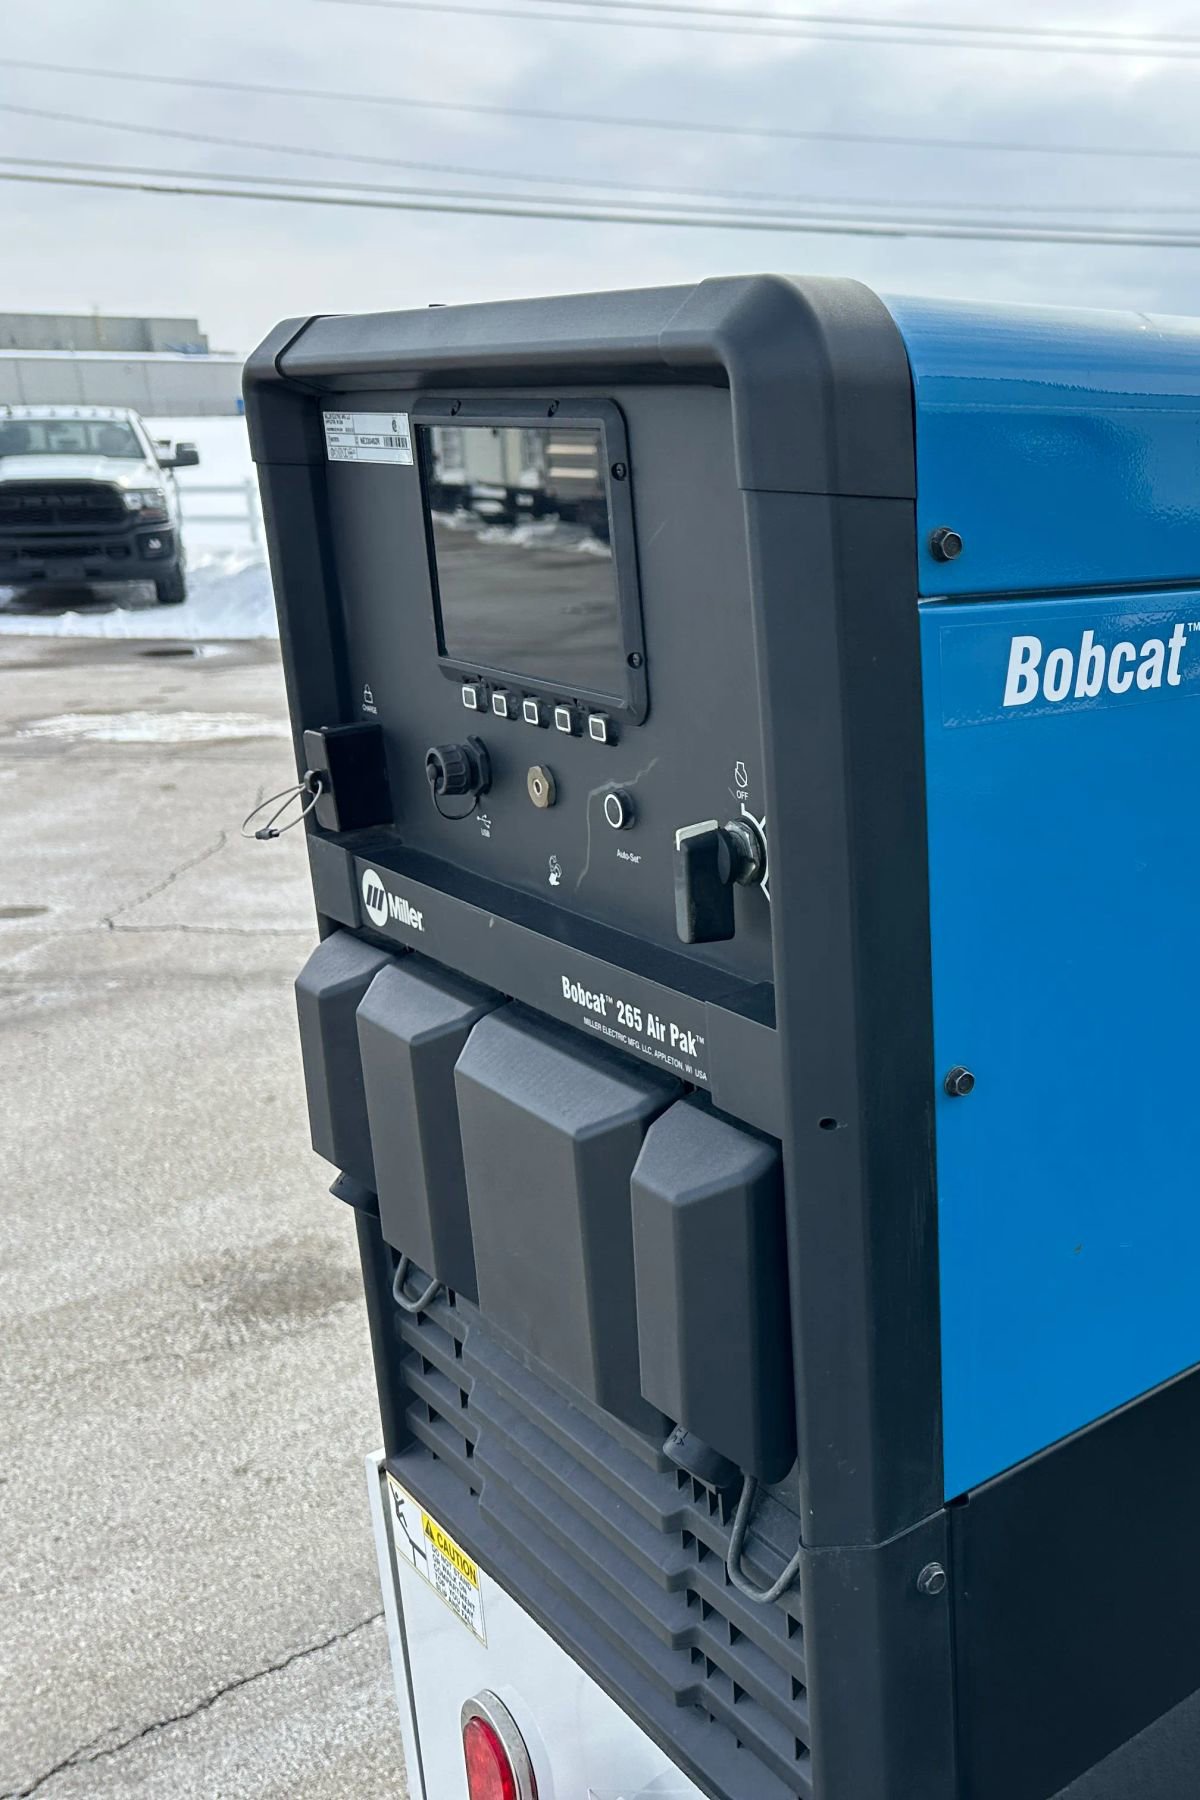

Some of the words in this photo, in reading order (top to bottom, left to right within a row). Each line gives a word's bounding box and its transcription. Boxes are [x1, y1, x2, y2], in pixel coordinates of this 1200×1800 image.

[736, 790, 748, 800] OFF
[616, 1000, 643, 1032] 265
[646, 1013, 666, 1042] Air
[583, 1016, 602, 1031] MILLER
[602, 1025, 628, 1044] ELECTRIC
[684, 1063, 693, 1075] WI
[694, 1068, 708, 1081] USA
[436, 1532, 477, 1585] CAUTION
